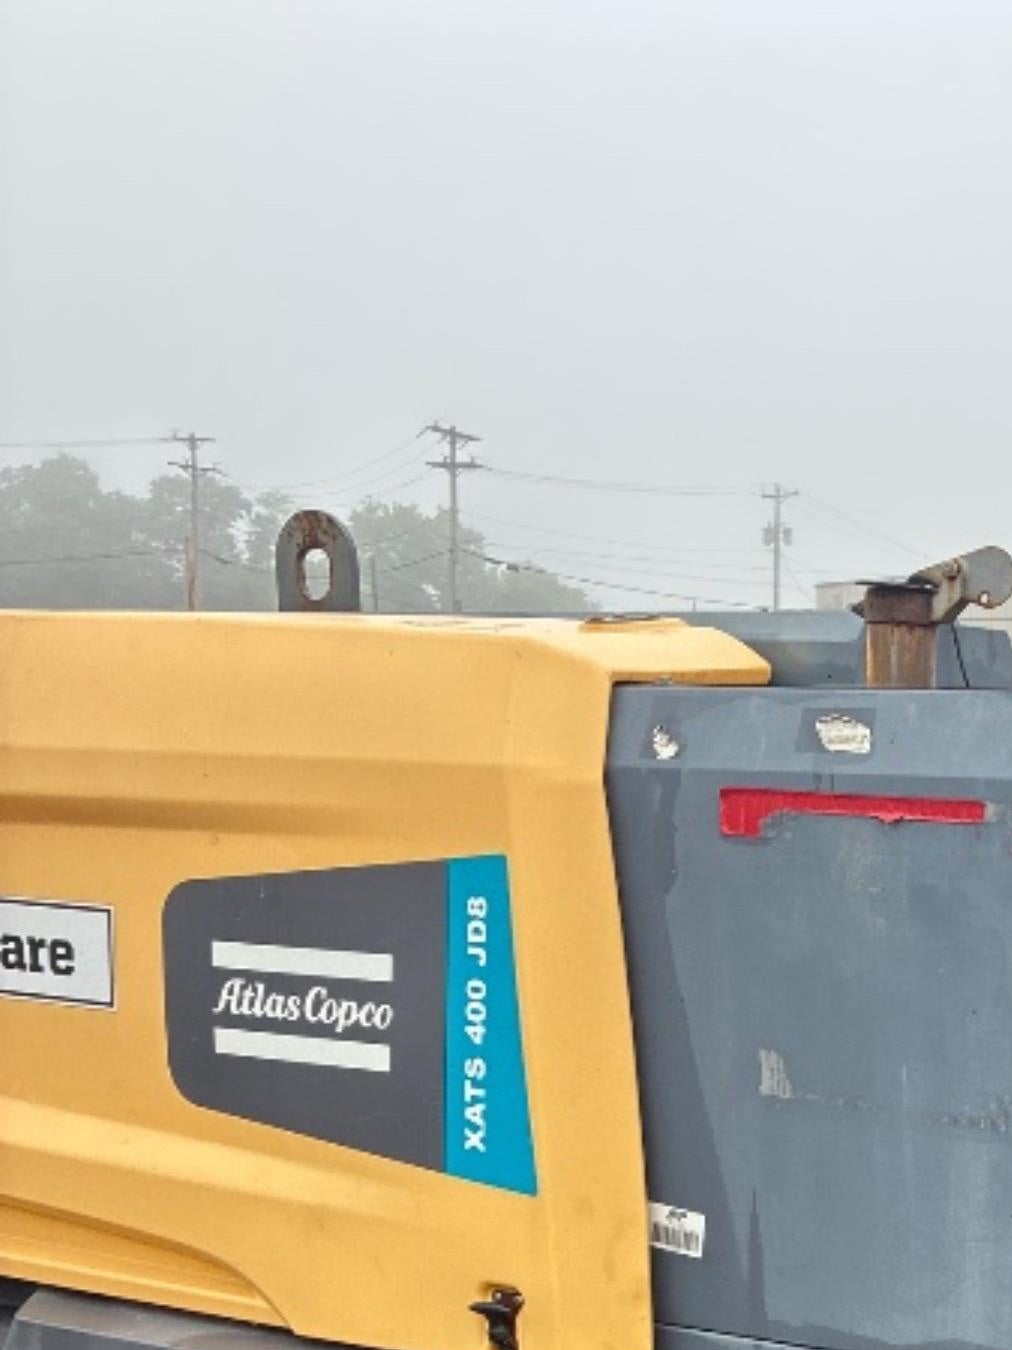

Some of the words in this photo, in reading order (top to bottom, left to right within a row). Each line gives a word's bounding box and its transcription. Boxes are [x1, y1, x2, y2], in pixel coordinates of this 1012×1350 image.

[0, 934, 75, 976] are
[465, 895, 488, 968] JD8
[212, 976, 301, 1021] Atlas
[304, 985, 394, 1034] Copco
[463, 978, 488, 1045] 400
[463, 1056, 487, 1153] XATS
